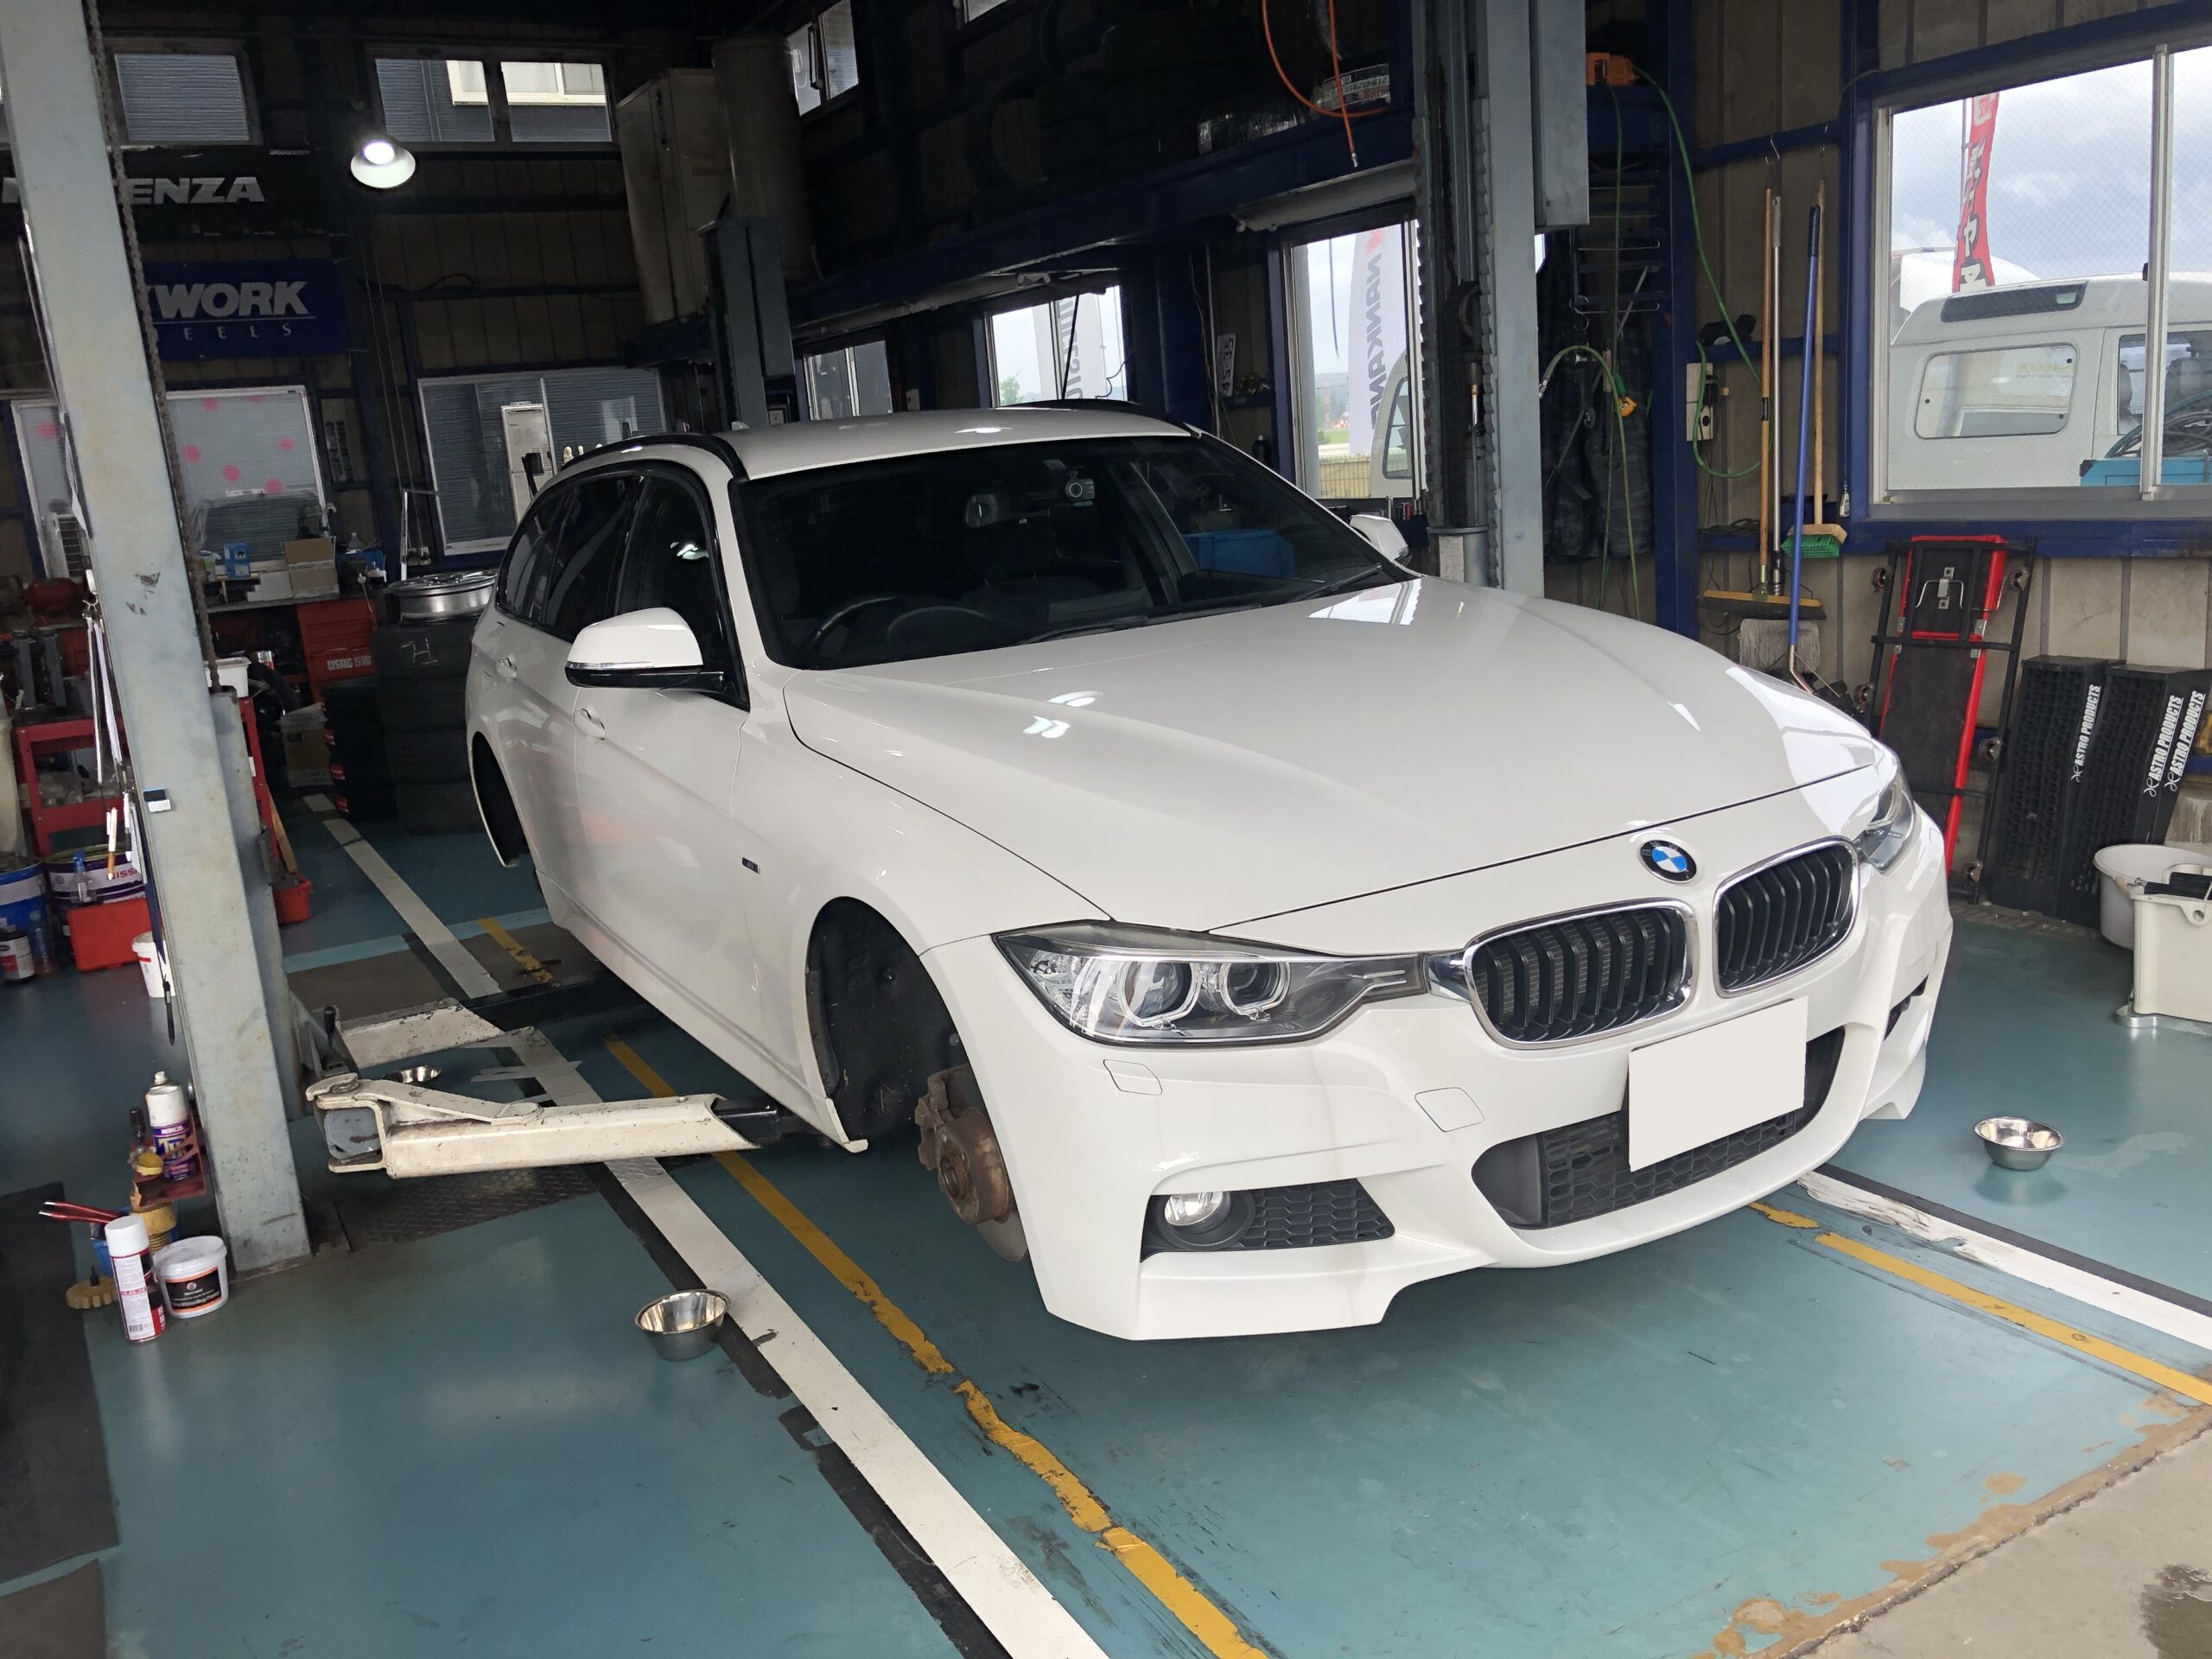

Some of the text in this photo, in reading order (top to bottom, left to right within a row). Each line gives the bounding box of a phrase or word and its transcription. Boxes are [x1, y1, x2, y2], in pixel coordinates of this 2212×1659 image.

[152, 281, 309, 319] WORK
[183, 323, 292, 340] EELS
[2075, 684, 2101, 766] ASTRO PRODUCTS
[2148, 695, 2183, 781] ASTRO PRODUCTS
[2170, 690, 2205, 777] ASTRO PRODUCTS
